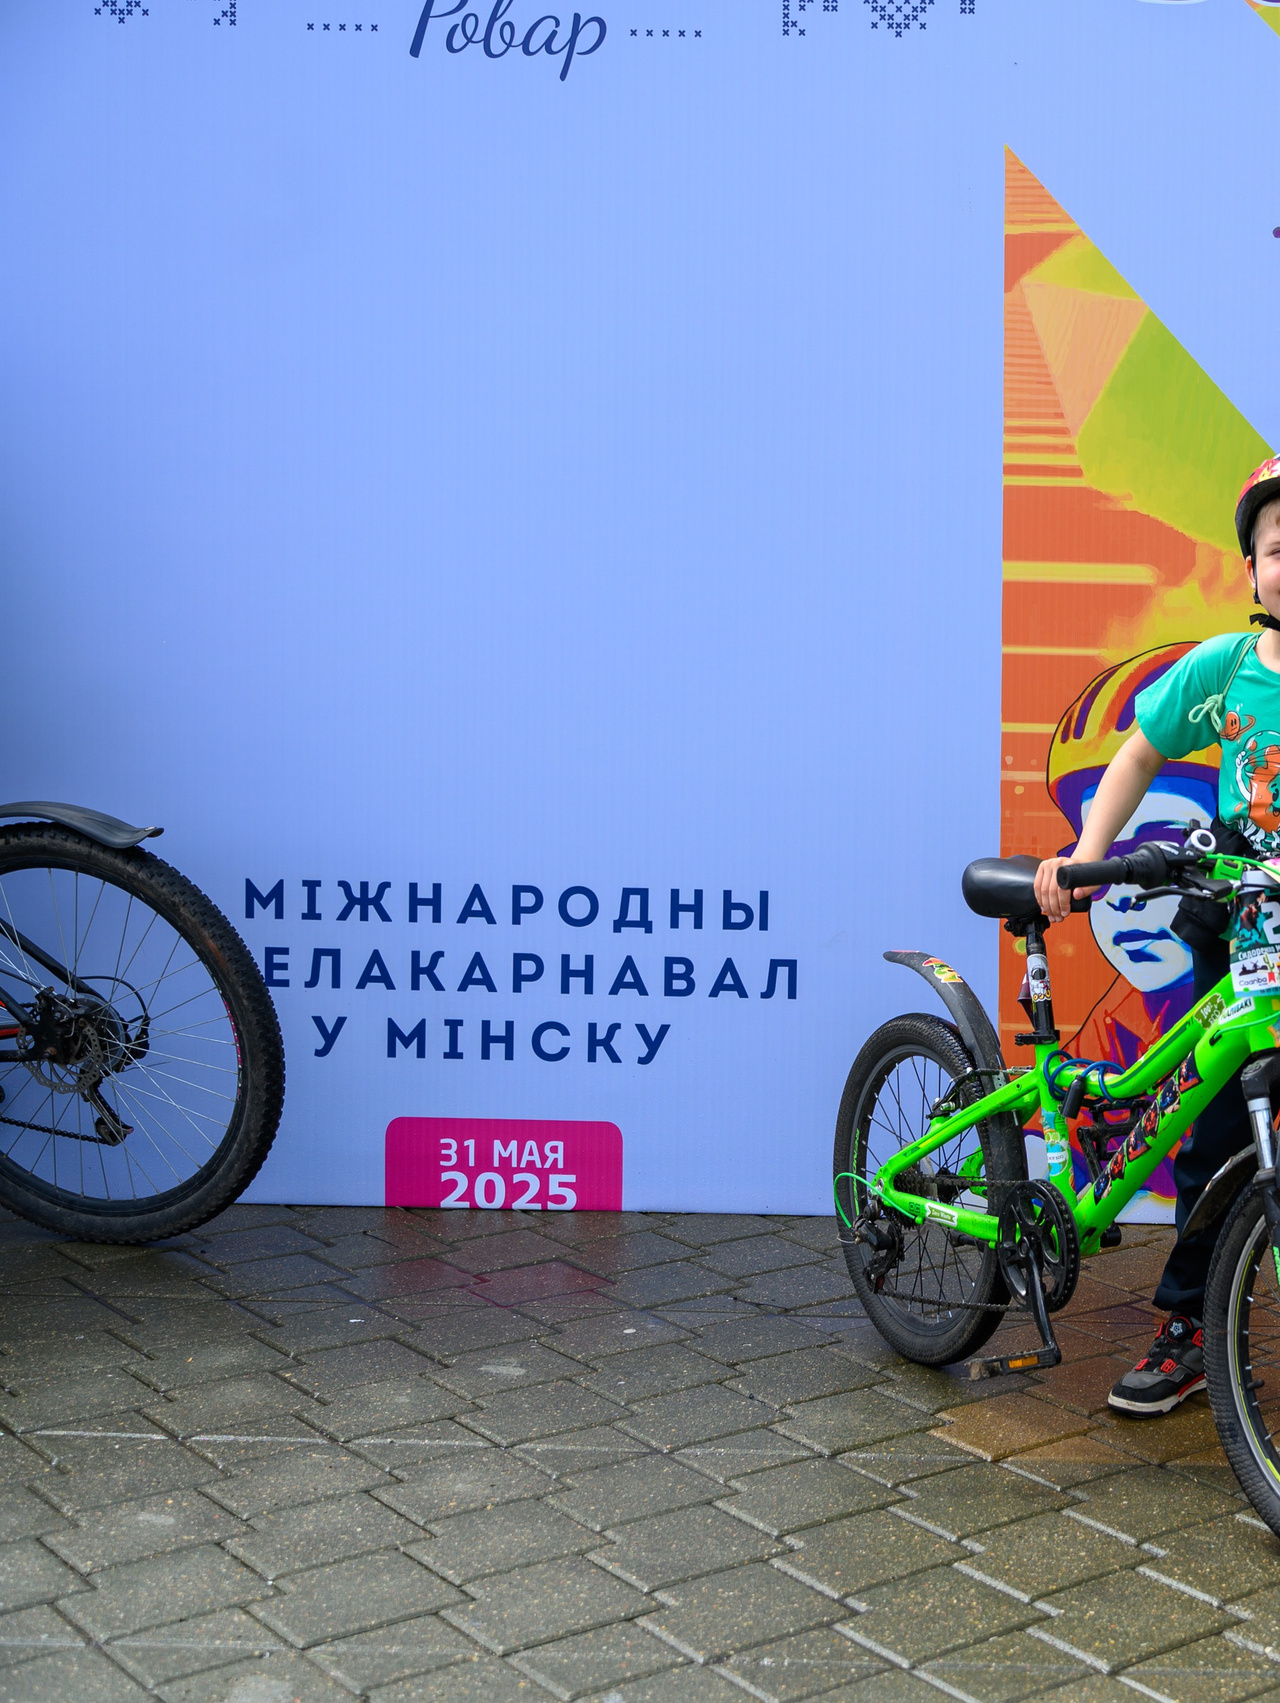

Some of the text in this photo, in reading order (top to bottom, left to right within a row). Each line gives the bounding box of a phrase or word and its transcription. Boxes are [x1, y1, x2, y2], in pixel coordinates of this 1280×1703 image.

[244, 878, 769, 934] МІЖНАРОДНЫ
[312, 1016, 671, 1065] У МІНСКУ
[440, 1138, 565, 1169] 31 МАЯ
[440, 1172, 578, 1211] 2025
